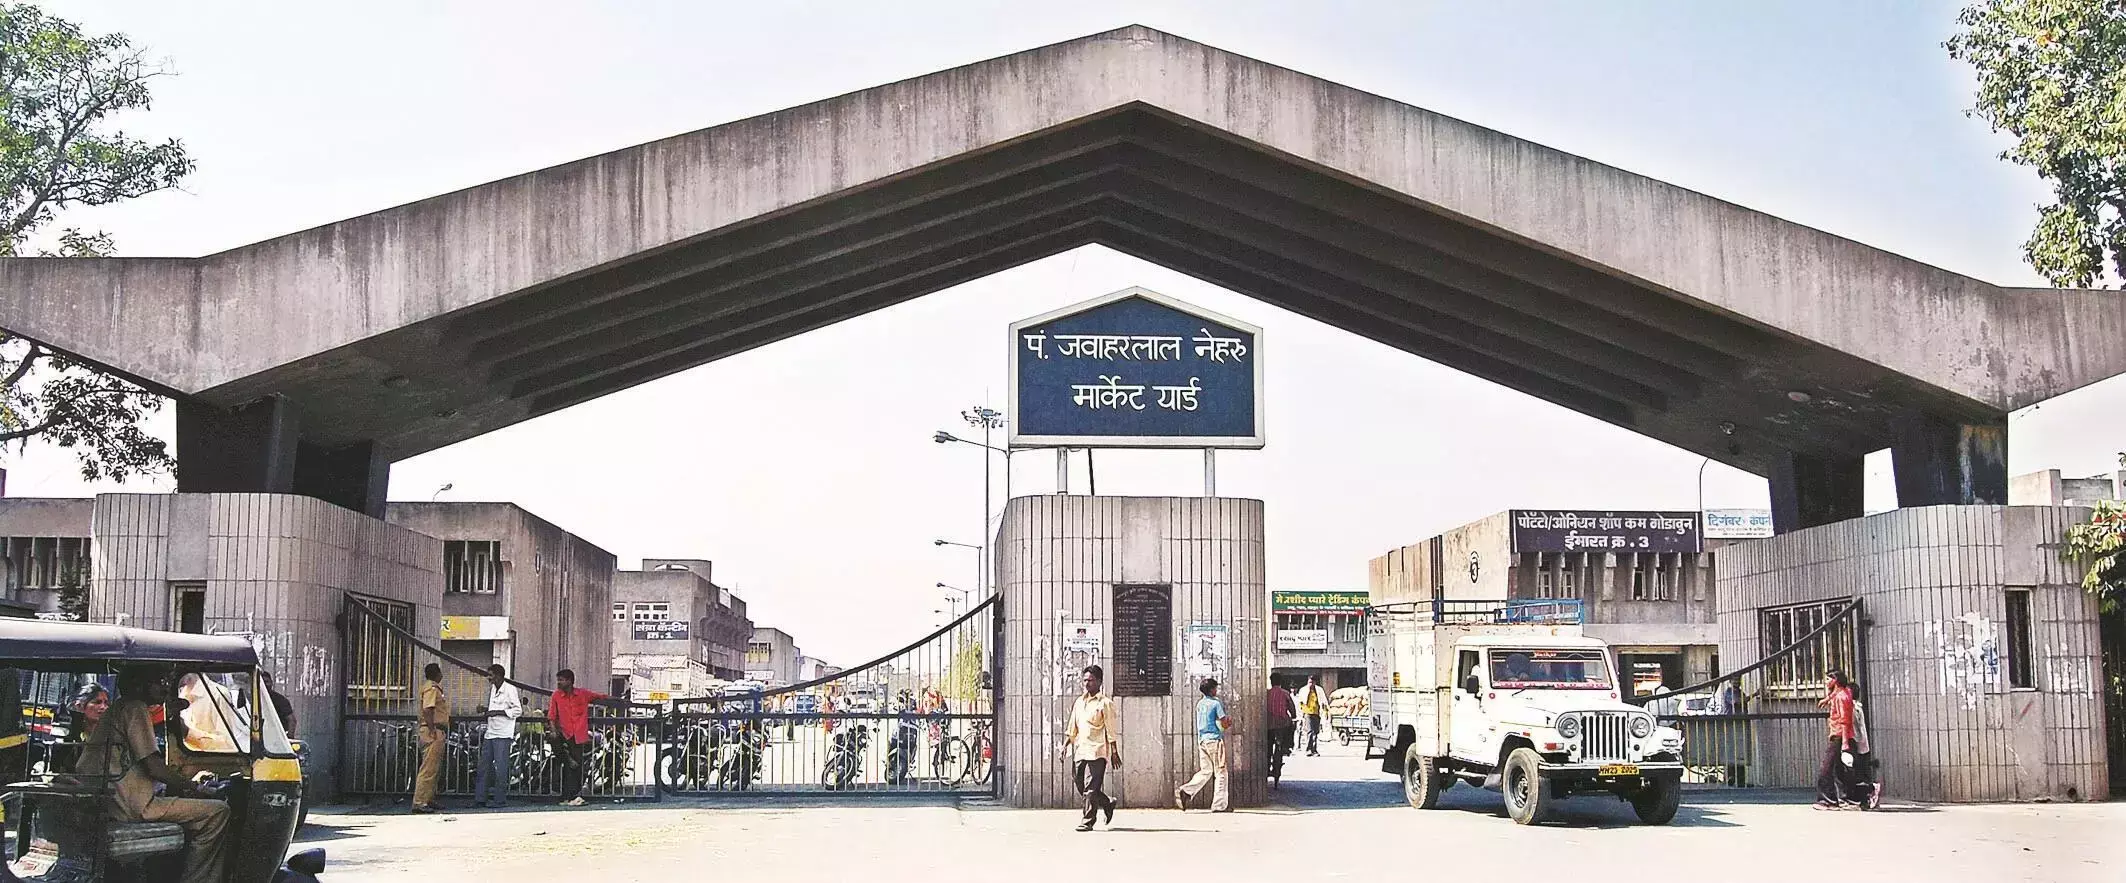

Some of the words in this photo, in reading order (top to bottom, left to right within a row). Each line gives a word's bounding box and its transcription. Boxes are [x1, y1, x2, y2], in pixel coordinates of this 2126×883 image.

[1023, 329, 1049, 360] पं.
[1053, 334, 1183, 361] जवाहरलाल
[1071, 374, 1146, 411] मार्केट
[1152, 376, 1202, 412] यार्ड
[1599, 512, 1622, 532] शॉप
[1624, 516, 1647, 530] कम
[1564, 530, 1609, 550] ईमारत
